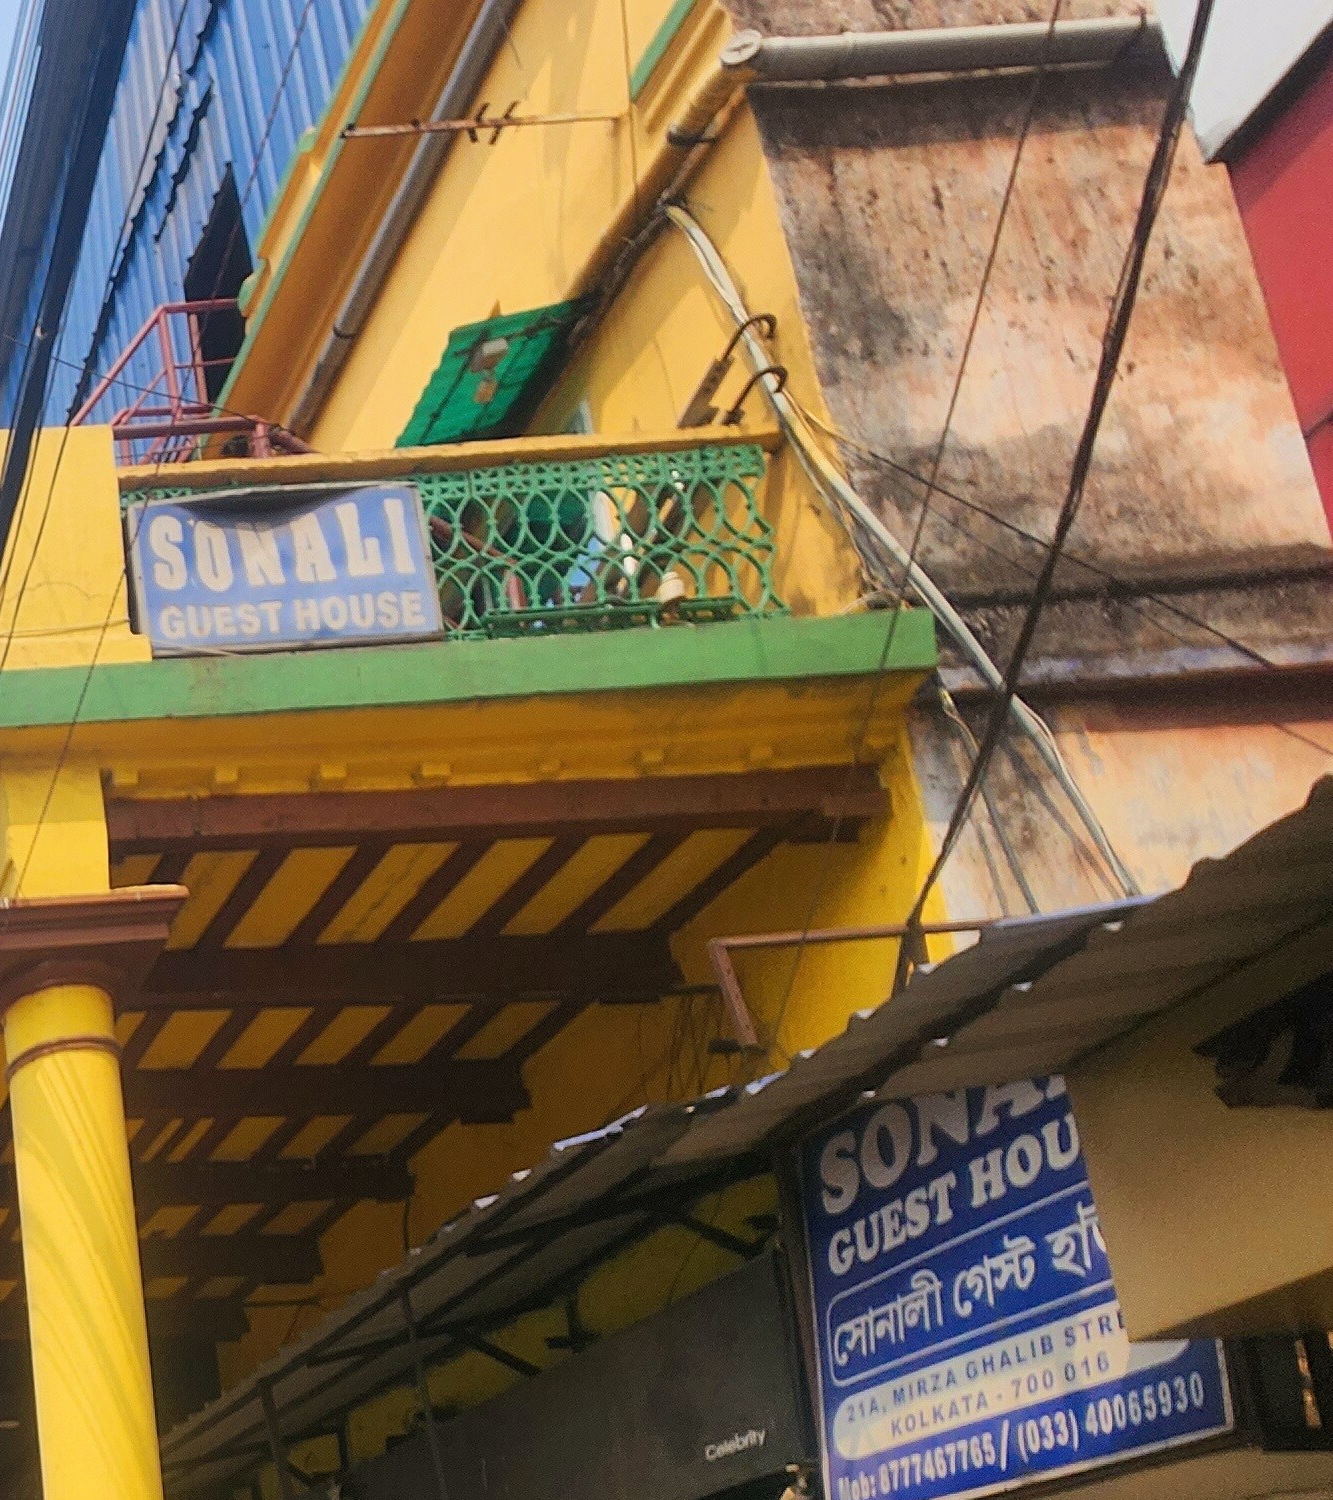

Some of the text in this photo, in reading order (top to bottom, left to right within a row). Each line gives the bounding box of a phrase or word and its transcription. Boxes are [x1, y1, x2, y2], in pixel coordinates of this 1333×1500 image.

[149, 498, 416, 593] SONALI
[160, 590, 426, 640] GUEST HOUSE
[820, 1074, 1067, 1215] SONA
[828, 1112, 1081, 1276] GUEST HOU
[833, 1268, 944, 1367] সোনালী
[953, 1234, 1036, 1318] গেস্ট
[890, 1395, 989, 1439] KOLKATA
[1011, 1368, 1055, 1399] 700
[1064, 1351, 1110, 1382] 016
[892, 1367, 958, 1406] MIRZA
[965, 1333, 1055, 1381] GHALIB
[1063, 1307, 1127, 1347] STRE
[705, 1428, 766, 1460] Celebrity
[1017, 1408, 1080, 1464] (033)
[1084, 1371, 1205, 1438] 40065930
